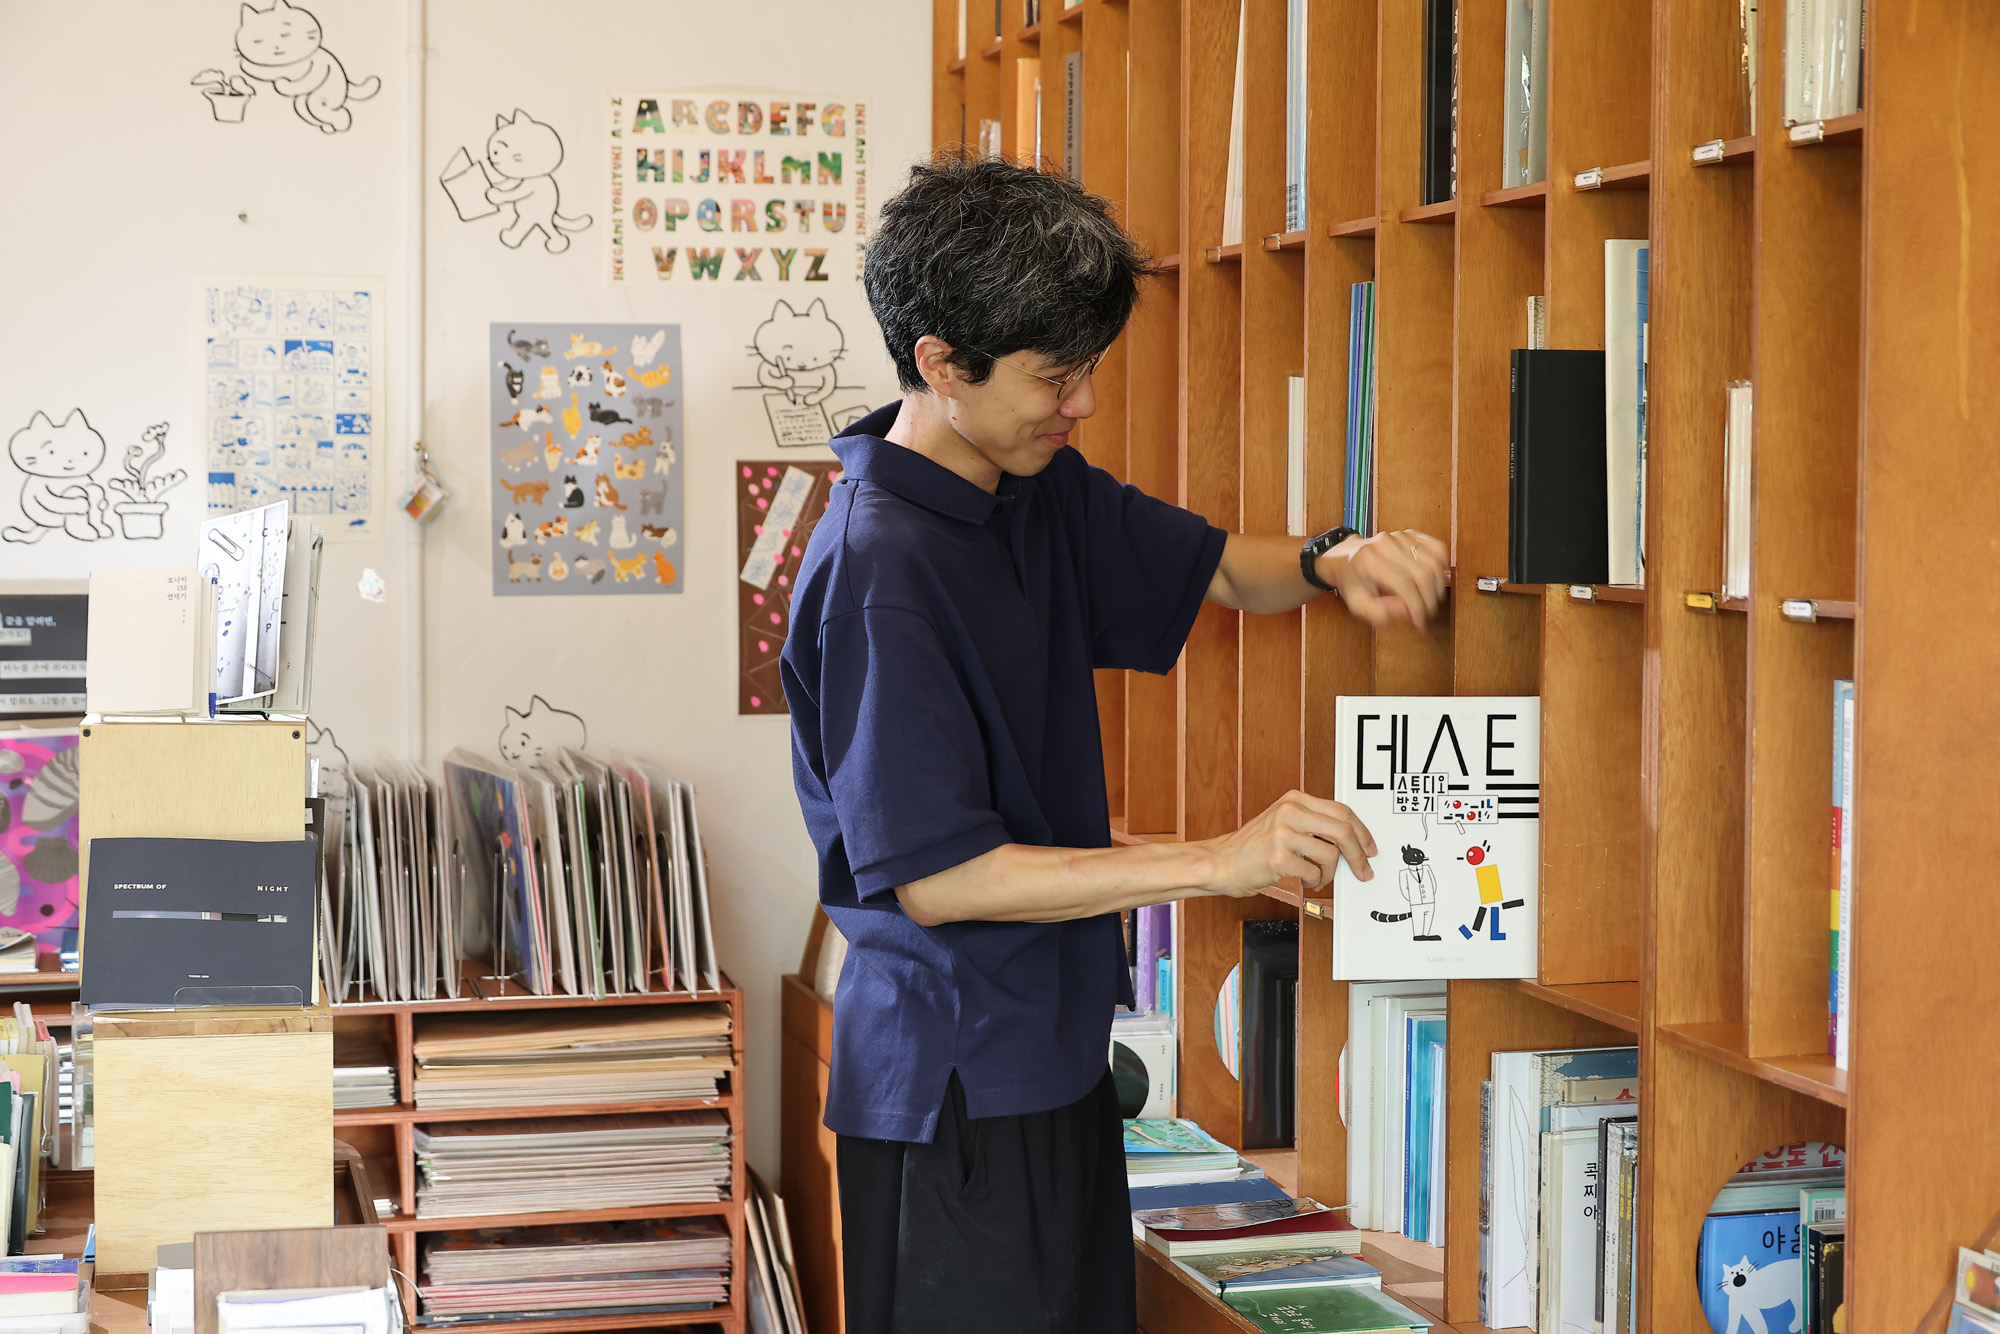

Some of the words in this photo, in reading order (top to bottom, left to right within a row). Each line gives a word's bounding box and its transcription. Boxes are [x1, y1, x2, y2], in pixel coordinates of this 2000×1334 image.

[632, 98, 846, 137] ABCDEFG
[632, 197, 847, 234] OPQRSTU
[651, 246, 829, 281] VWXYZ
[1397, 775, 1445, 794] 스튜디오
[1396, 796, 1434, 812] 방문기
